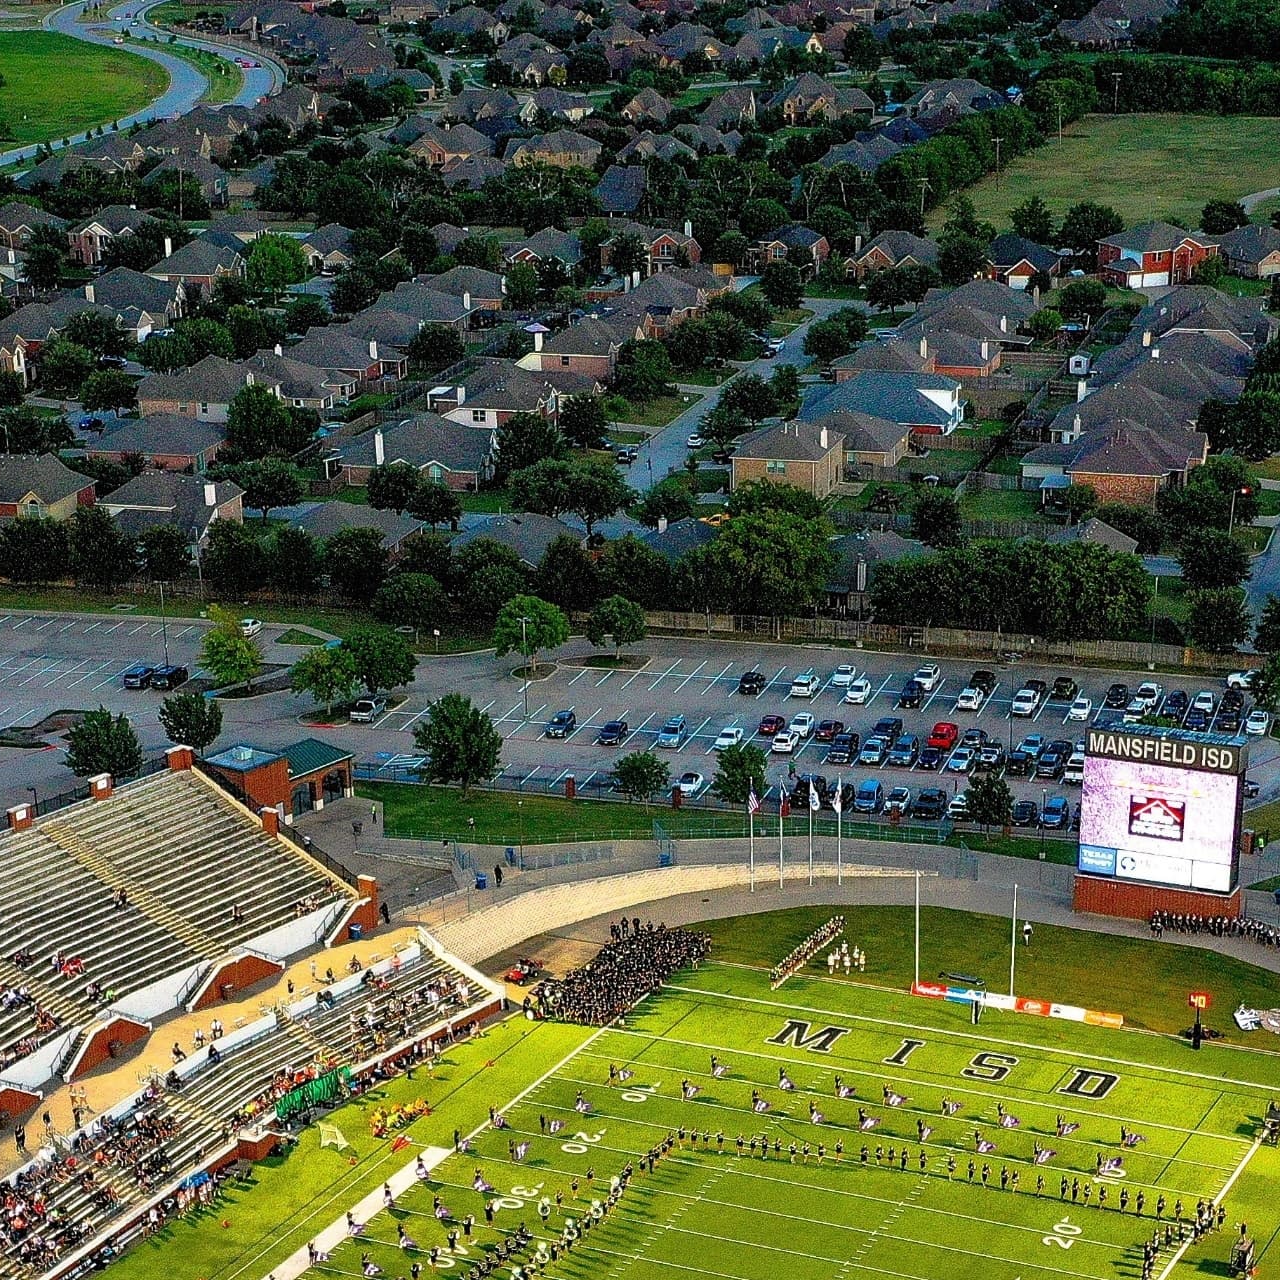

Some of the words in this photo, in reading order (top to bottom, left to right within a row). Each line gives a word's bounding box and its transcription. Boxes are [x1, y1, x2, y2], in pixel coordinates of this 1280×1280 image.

[1089, 732, 1196, 766] MANSFIELD
[1201, 749, 1234, 770] ISD
[764, 1020, 1120, 1100] MISD
[561, 1131, 601, 1154] 20
[497, 1186, 539, 1209] 30
[1042, 1223, 1083, 1249] 20
